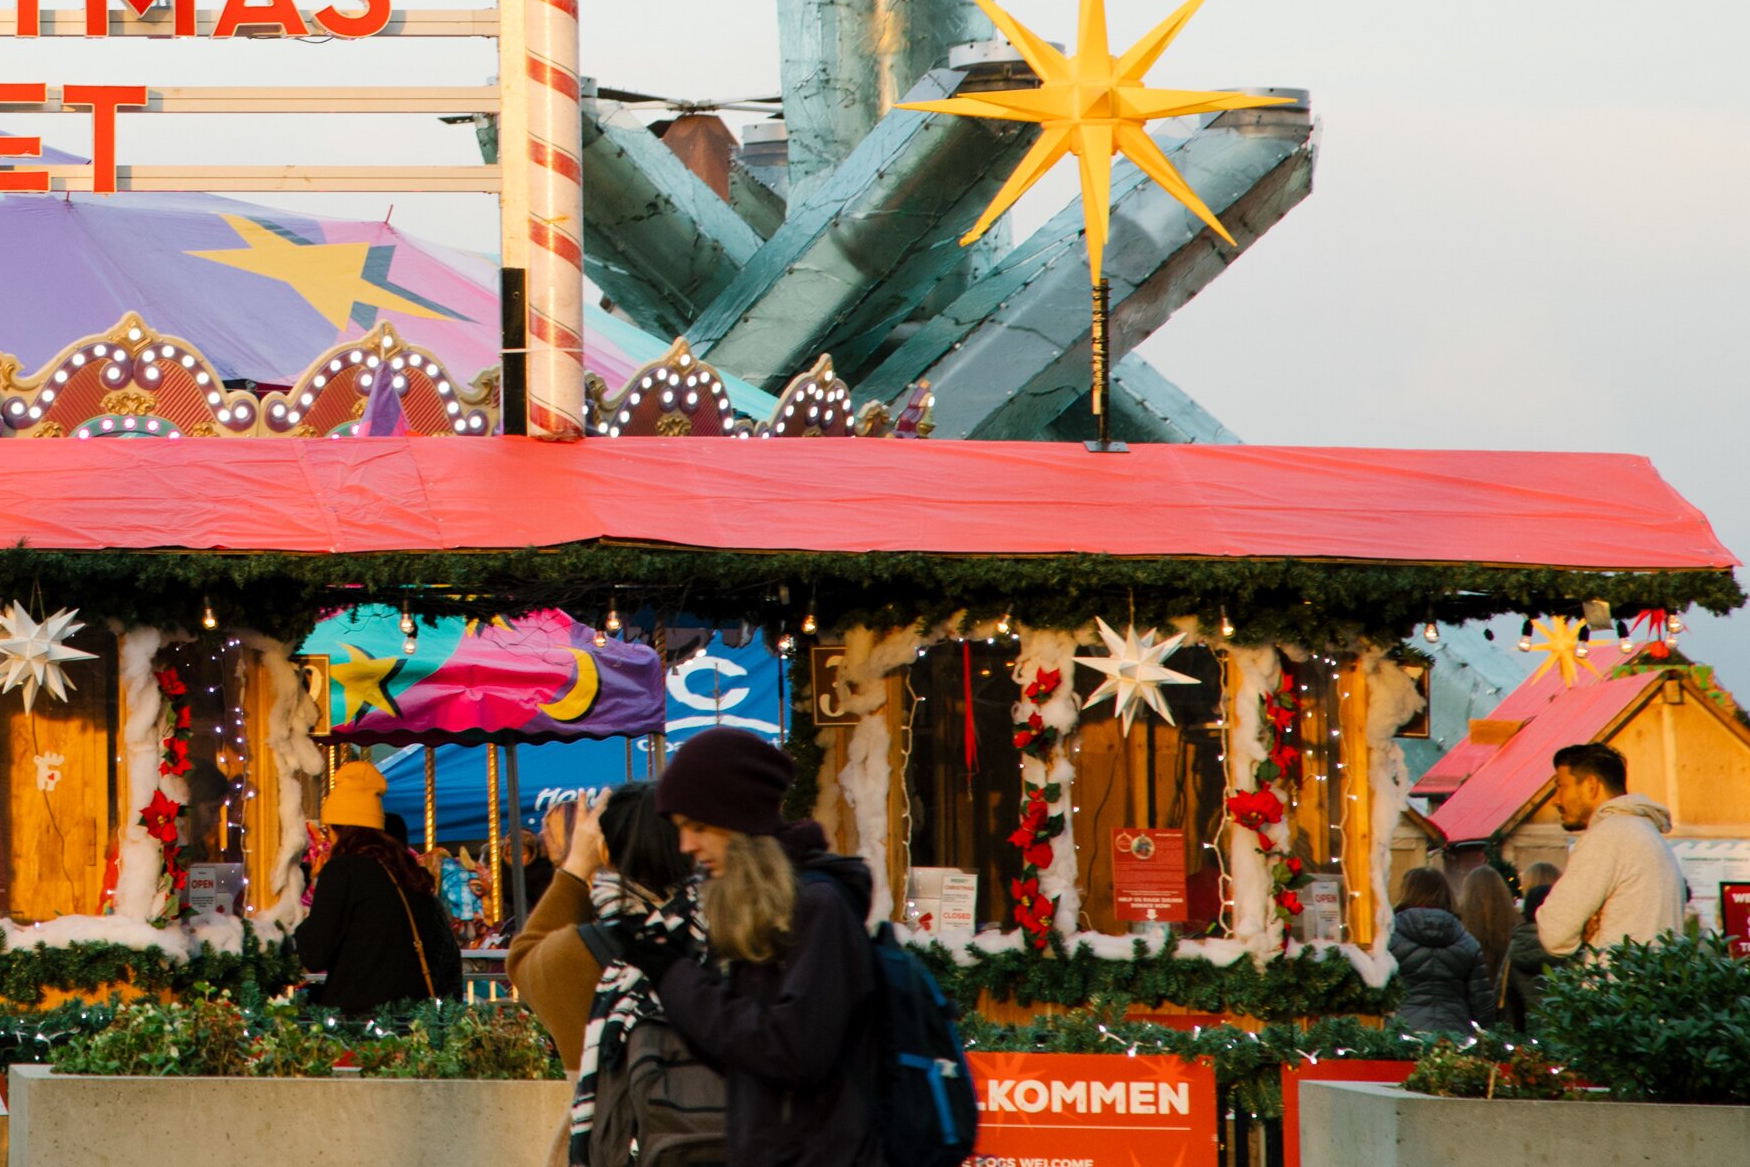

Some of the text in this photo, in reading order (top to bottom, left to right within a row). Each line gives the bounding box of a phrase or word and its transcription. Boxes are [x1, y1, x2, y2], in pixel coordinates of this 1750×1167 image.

[192, 880, 214, 889] OPEN
[1315, 894, 1338, 903] OPEN
[943, 912, 971, 920] CLOSED
[977, 1079, 1190, 1115] KOMMEN
[1019, 1158, 1095, 1167] WELCOME
